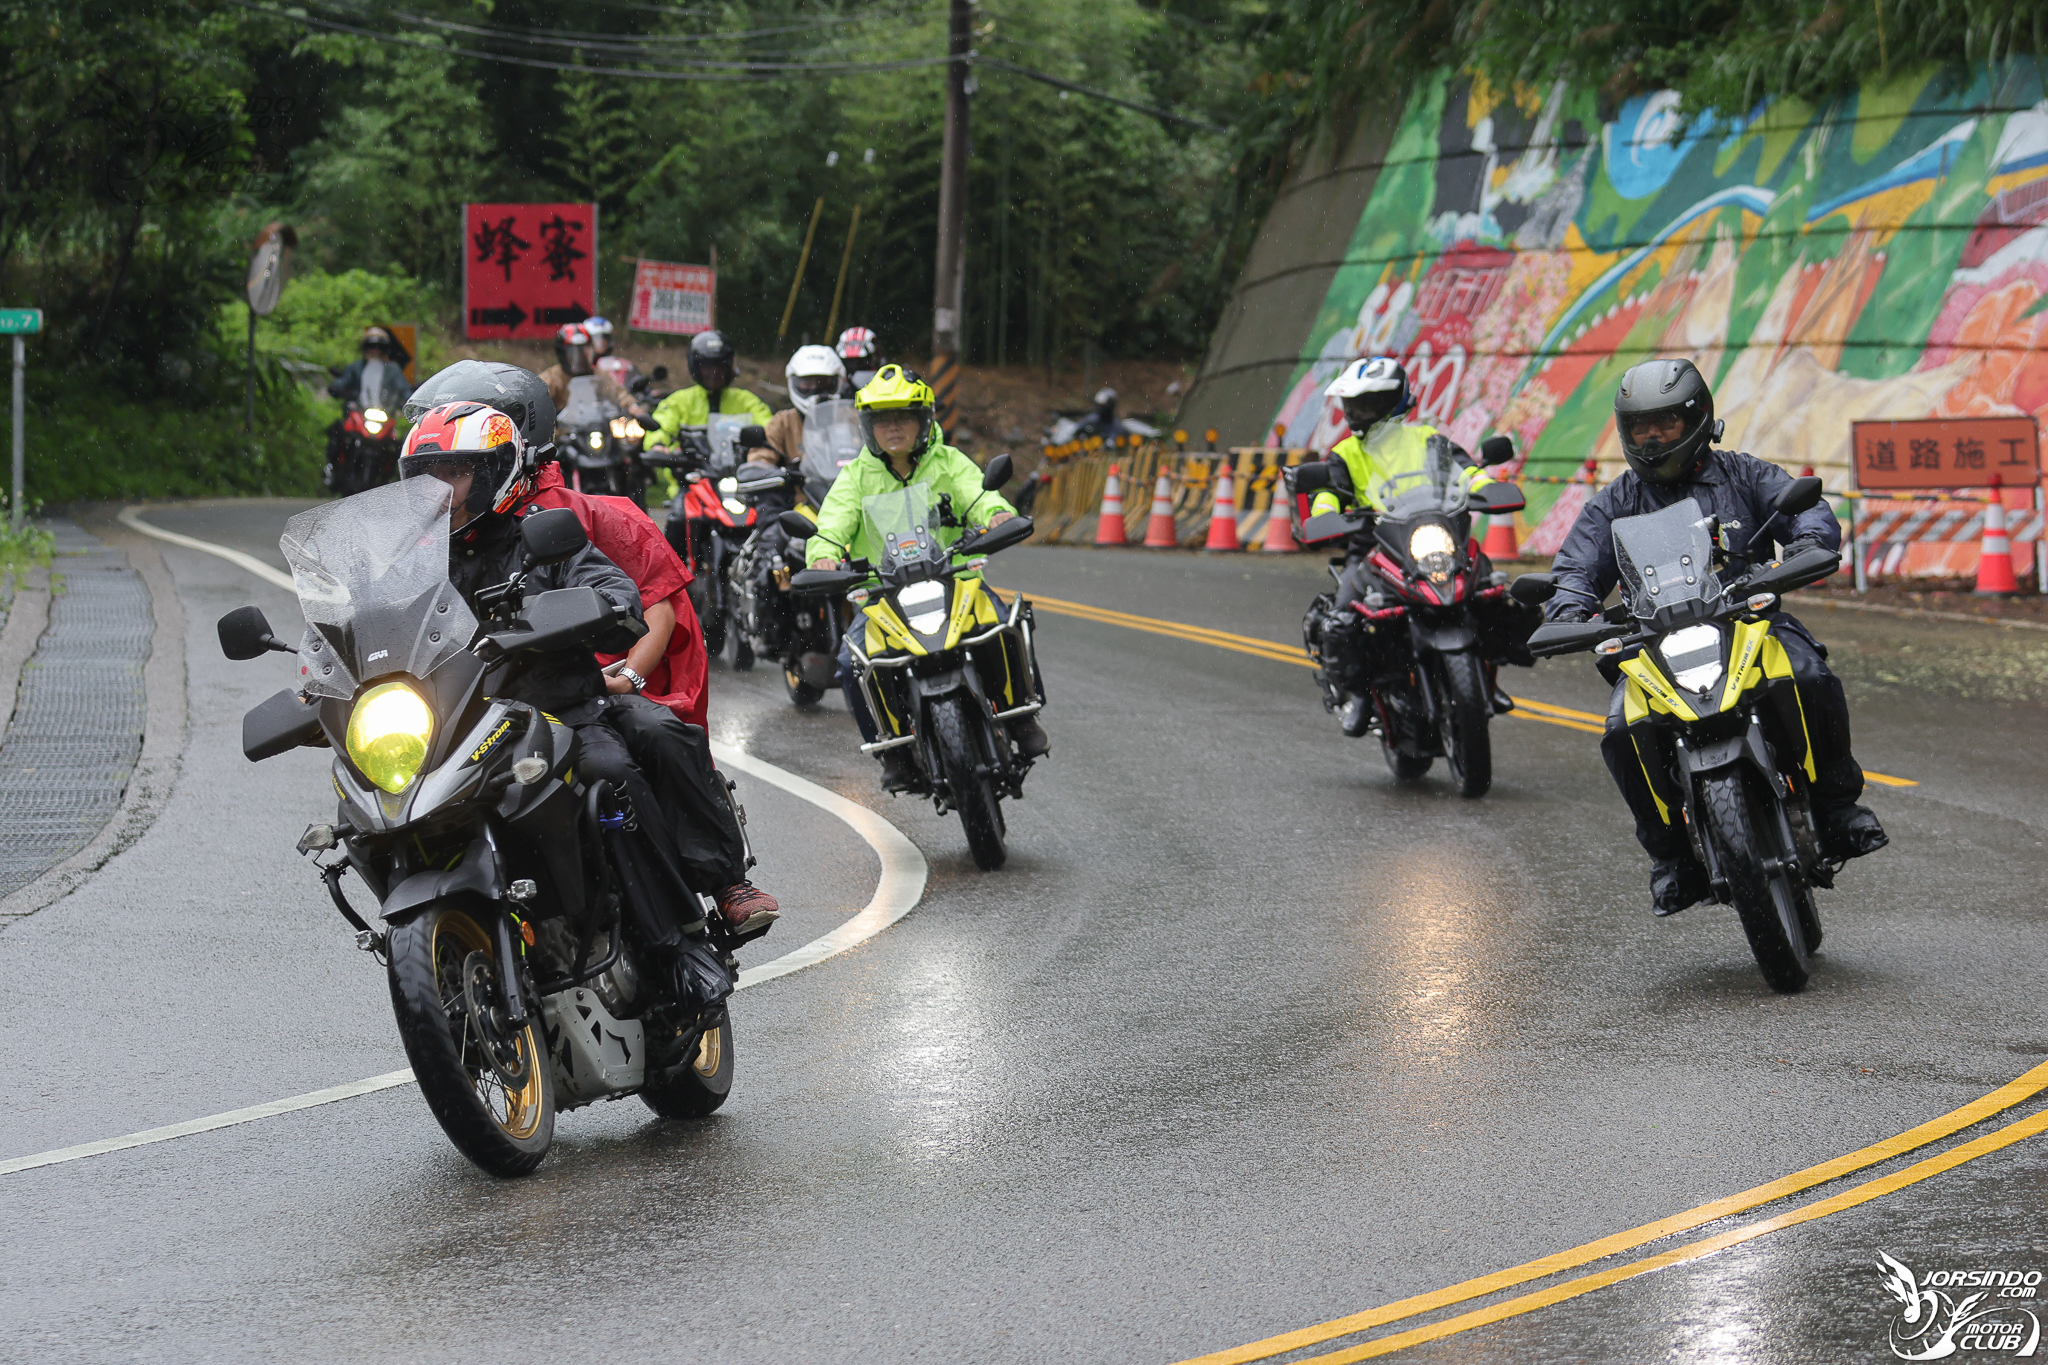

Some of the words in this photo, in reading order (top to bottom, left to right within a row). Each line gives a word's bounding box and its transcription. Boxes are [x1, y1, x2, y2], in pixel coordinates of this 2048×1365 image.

[474, 215, 586, 282] 蜂蜜
[1866, 438, 2028, 471] 道路施工
[1731, 653, 1749, 690] V-STROM
[1746, 640, 1754, 653] SX
[1638, 673, 1668, 698] V-STROM
[1666, 697, 1679, 708] SX
[471, 720, 511, 761] V-Strom
